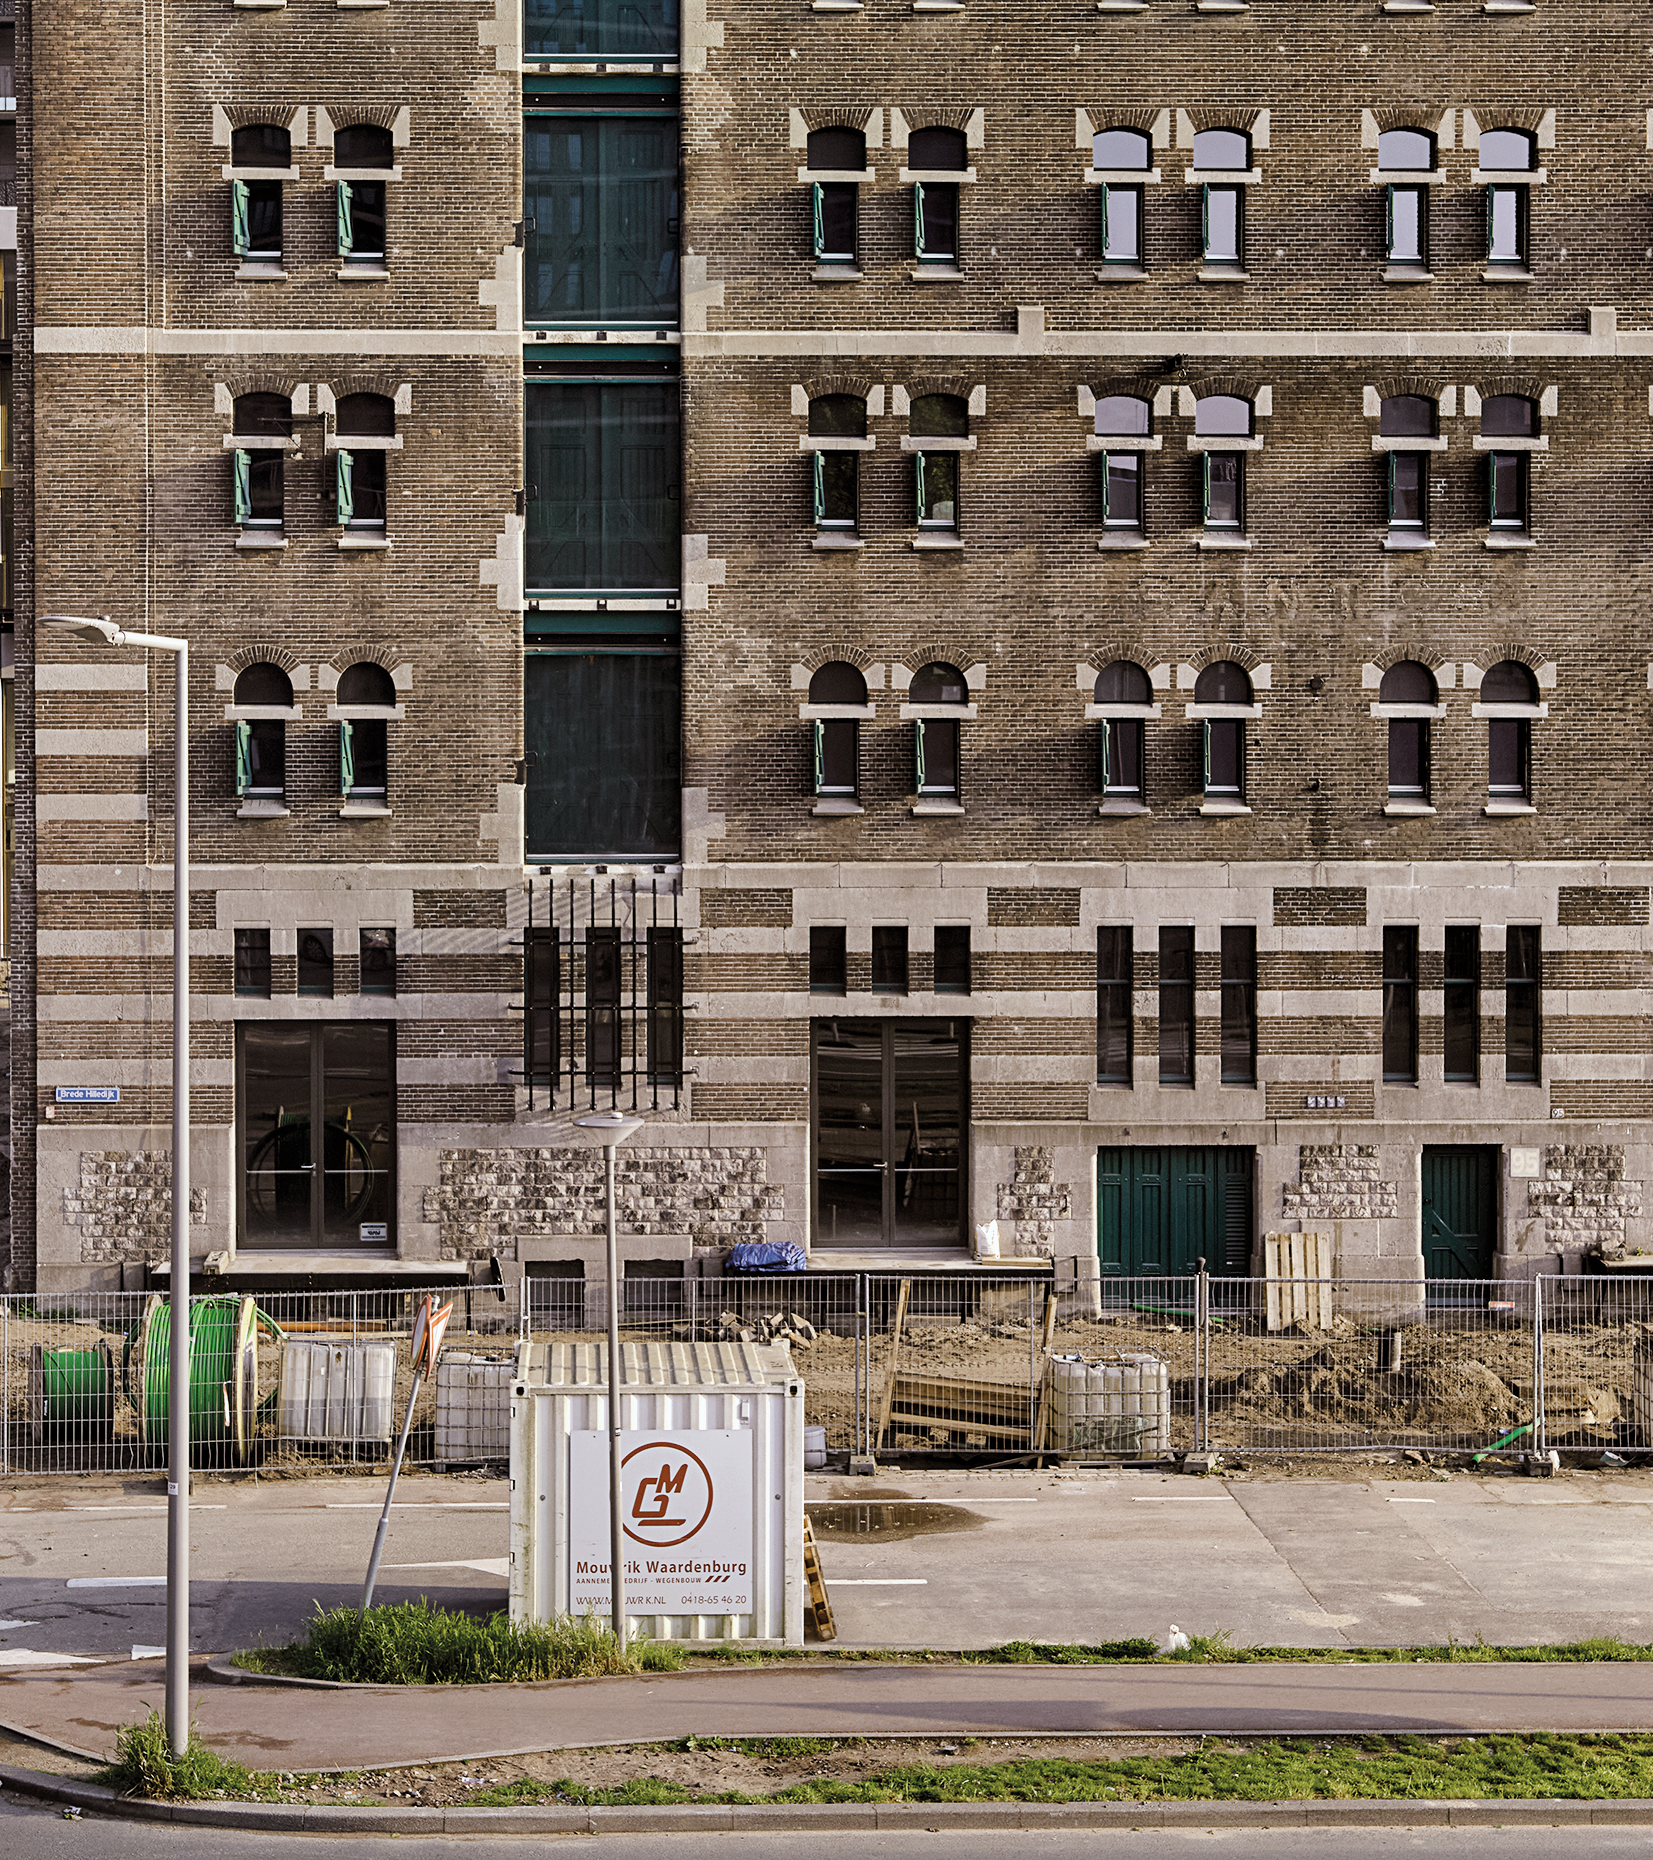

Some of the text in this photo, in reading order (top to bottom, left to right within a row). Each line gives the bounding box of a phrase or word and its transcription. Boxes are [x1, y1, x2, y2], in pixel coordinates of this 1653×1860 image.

[60, 1090, 115, 1100] Brede Hilledijk
[1552, 1109, 1564, 1117] 95
[1512, 1151, 1538, 1174] 95
[646, 1560, 747, 1576] Waardenburg
[681, 1595, 719, 1605] 0418-65
[721, 1595, 733, 1605] 46
[735, 1595, 747, 1605] 20
